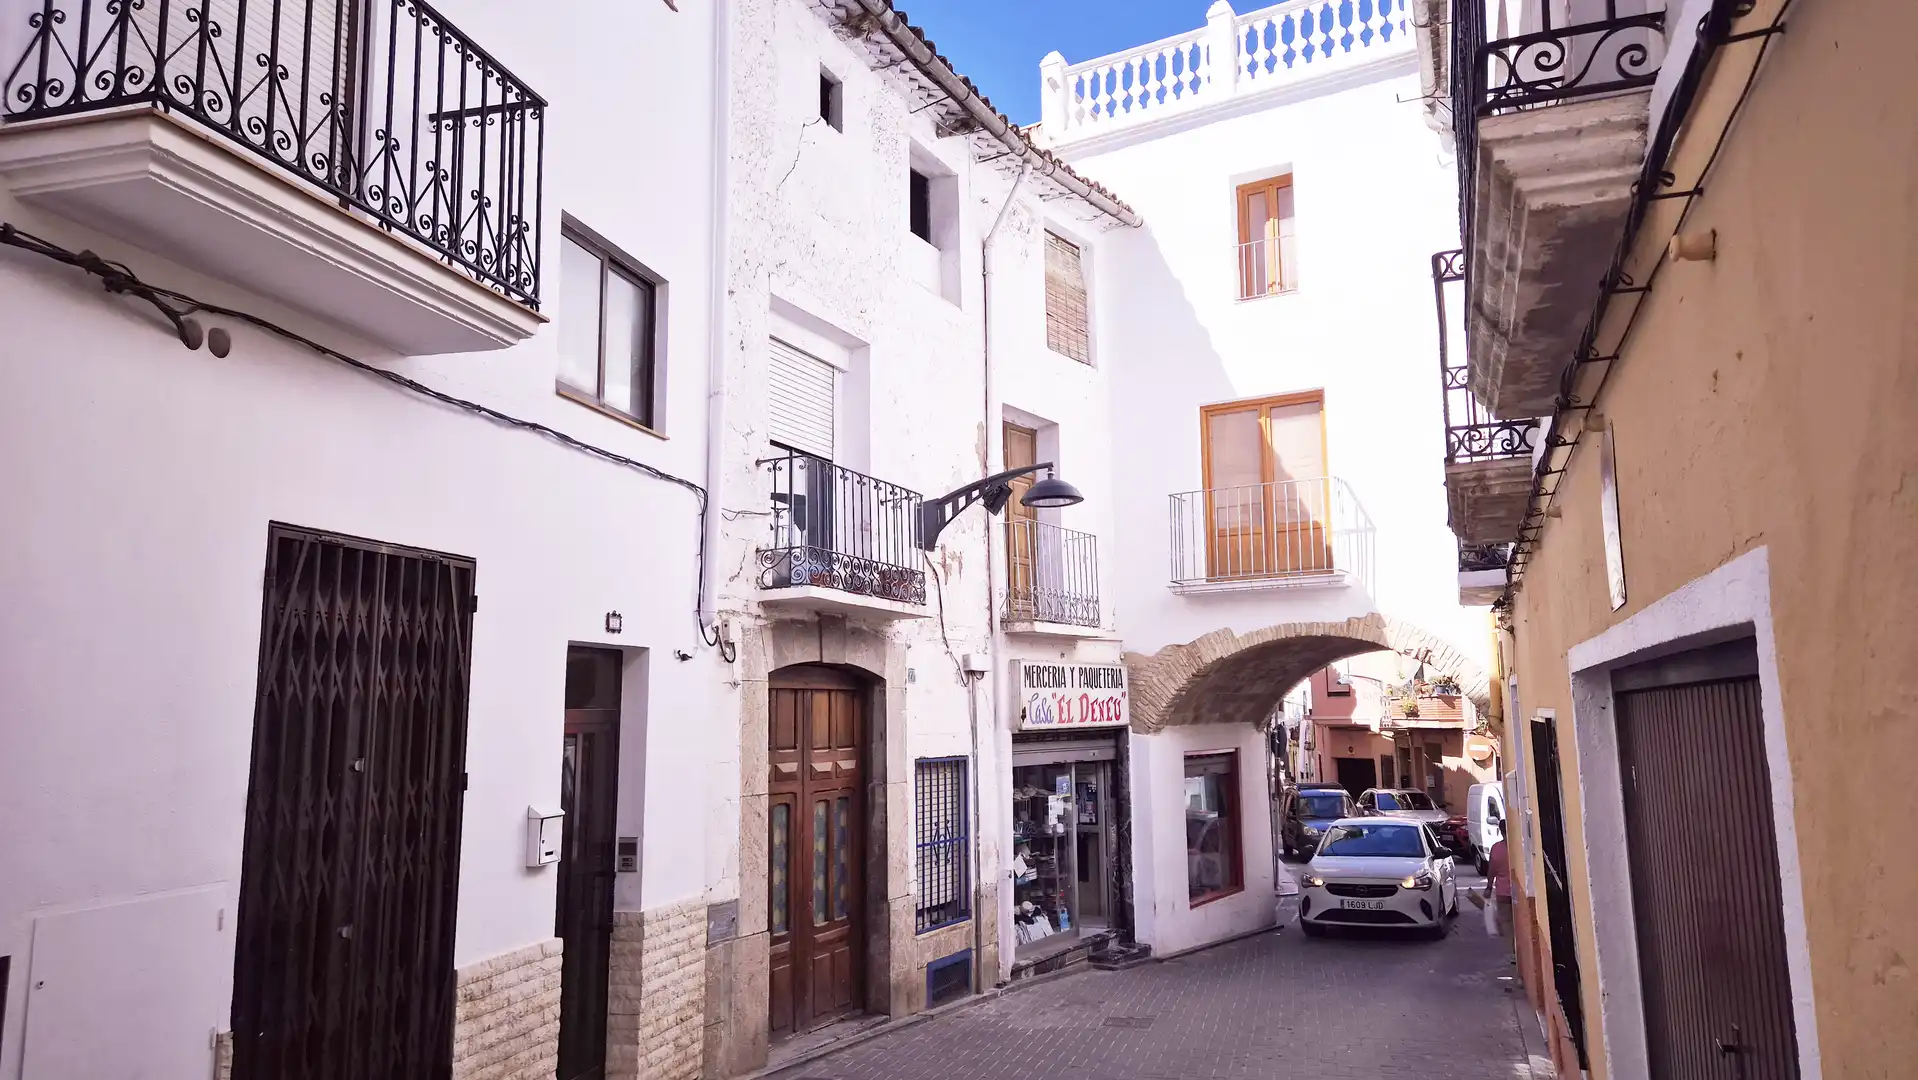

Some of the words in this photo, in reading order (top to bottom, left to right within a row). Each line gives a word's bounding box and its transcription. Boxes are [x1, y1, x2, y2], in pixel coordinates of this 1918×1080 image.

[1024, 665, 1066, 688] MERCERIA
[1069, 666, 1076, 688] Y
[1079, 666, 1124, 689] PAQUETERIA
[1028, 692, 1054, 724] Casa
[1346, 901, 1366, 909] 1609
